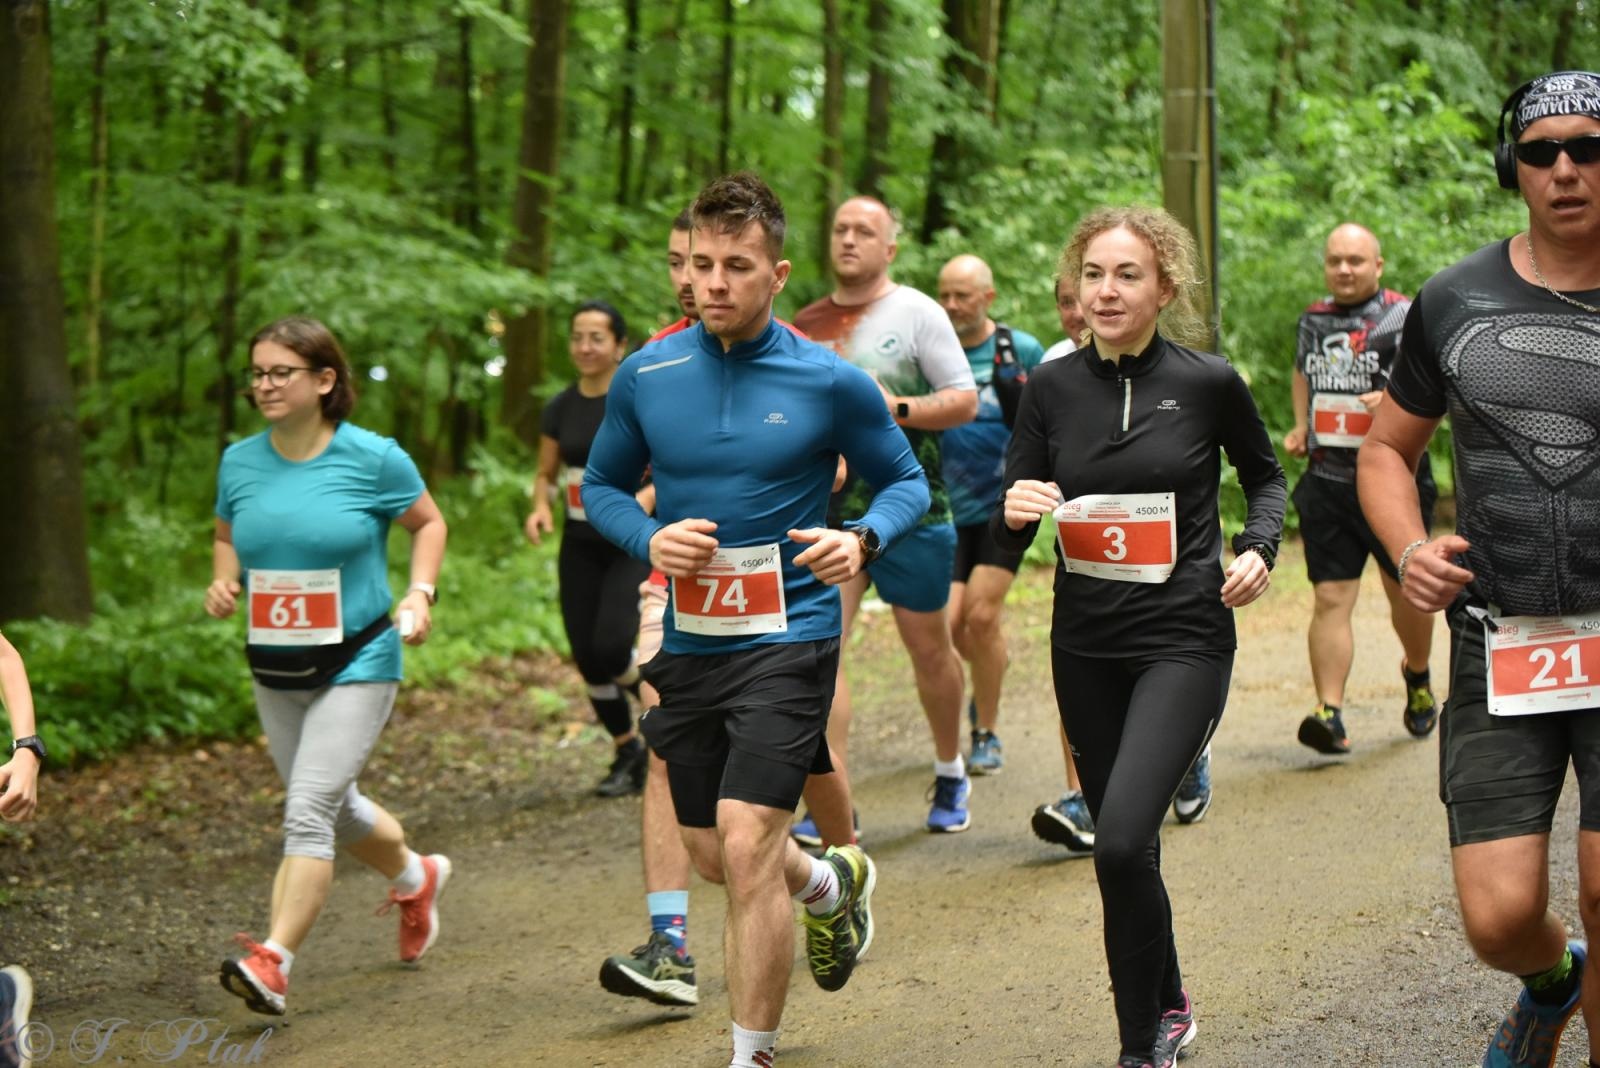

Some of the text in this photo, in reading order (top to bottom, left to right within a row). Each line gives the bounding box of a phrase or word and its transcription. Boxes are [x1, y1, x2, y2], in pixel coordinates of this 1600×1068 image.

[1335, 414, 1348, 434] 1
[1136, 506, 1169, 515] 4500 M
[1103, 526, 1127, 561] 3
[741, 558, 763, 568] 4500
[696, 578, 748, 613] 74
[270, 596, 312, 627] 61
[1529, 643, 1589, 688] 21
